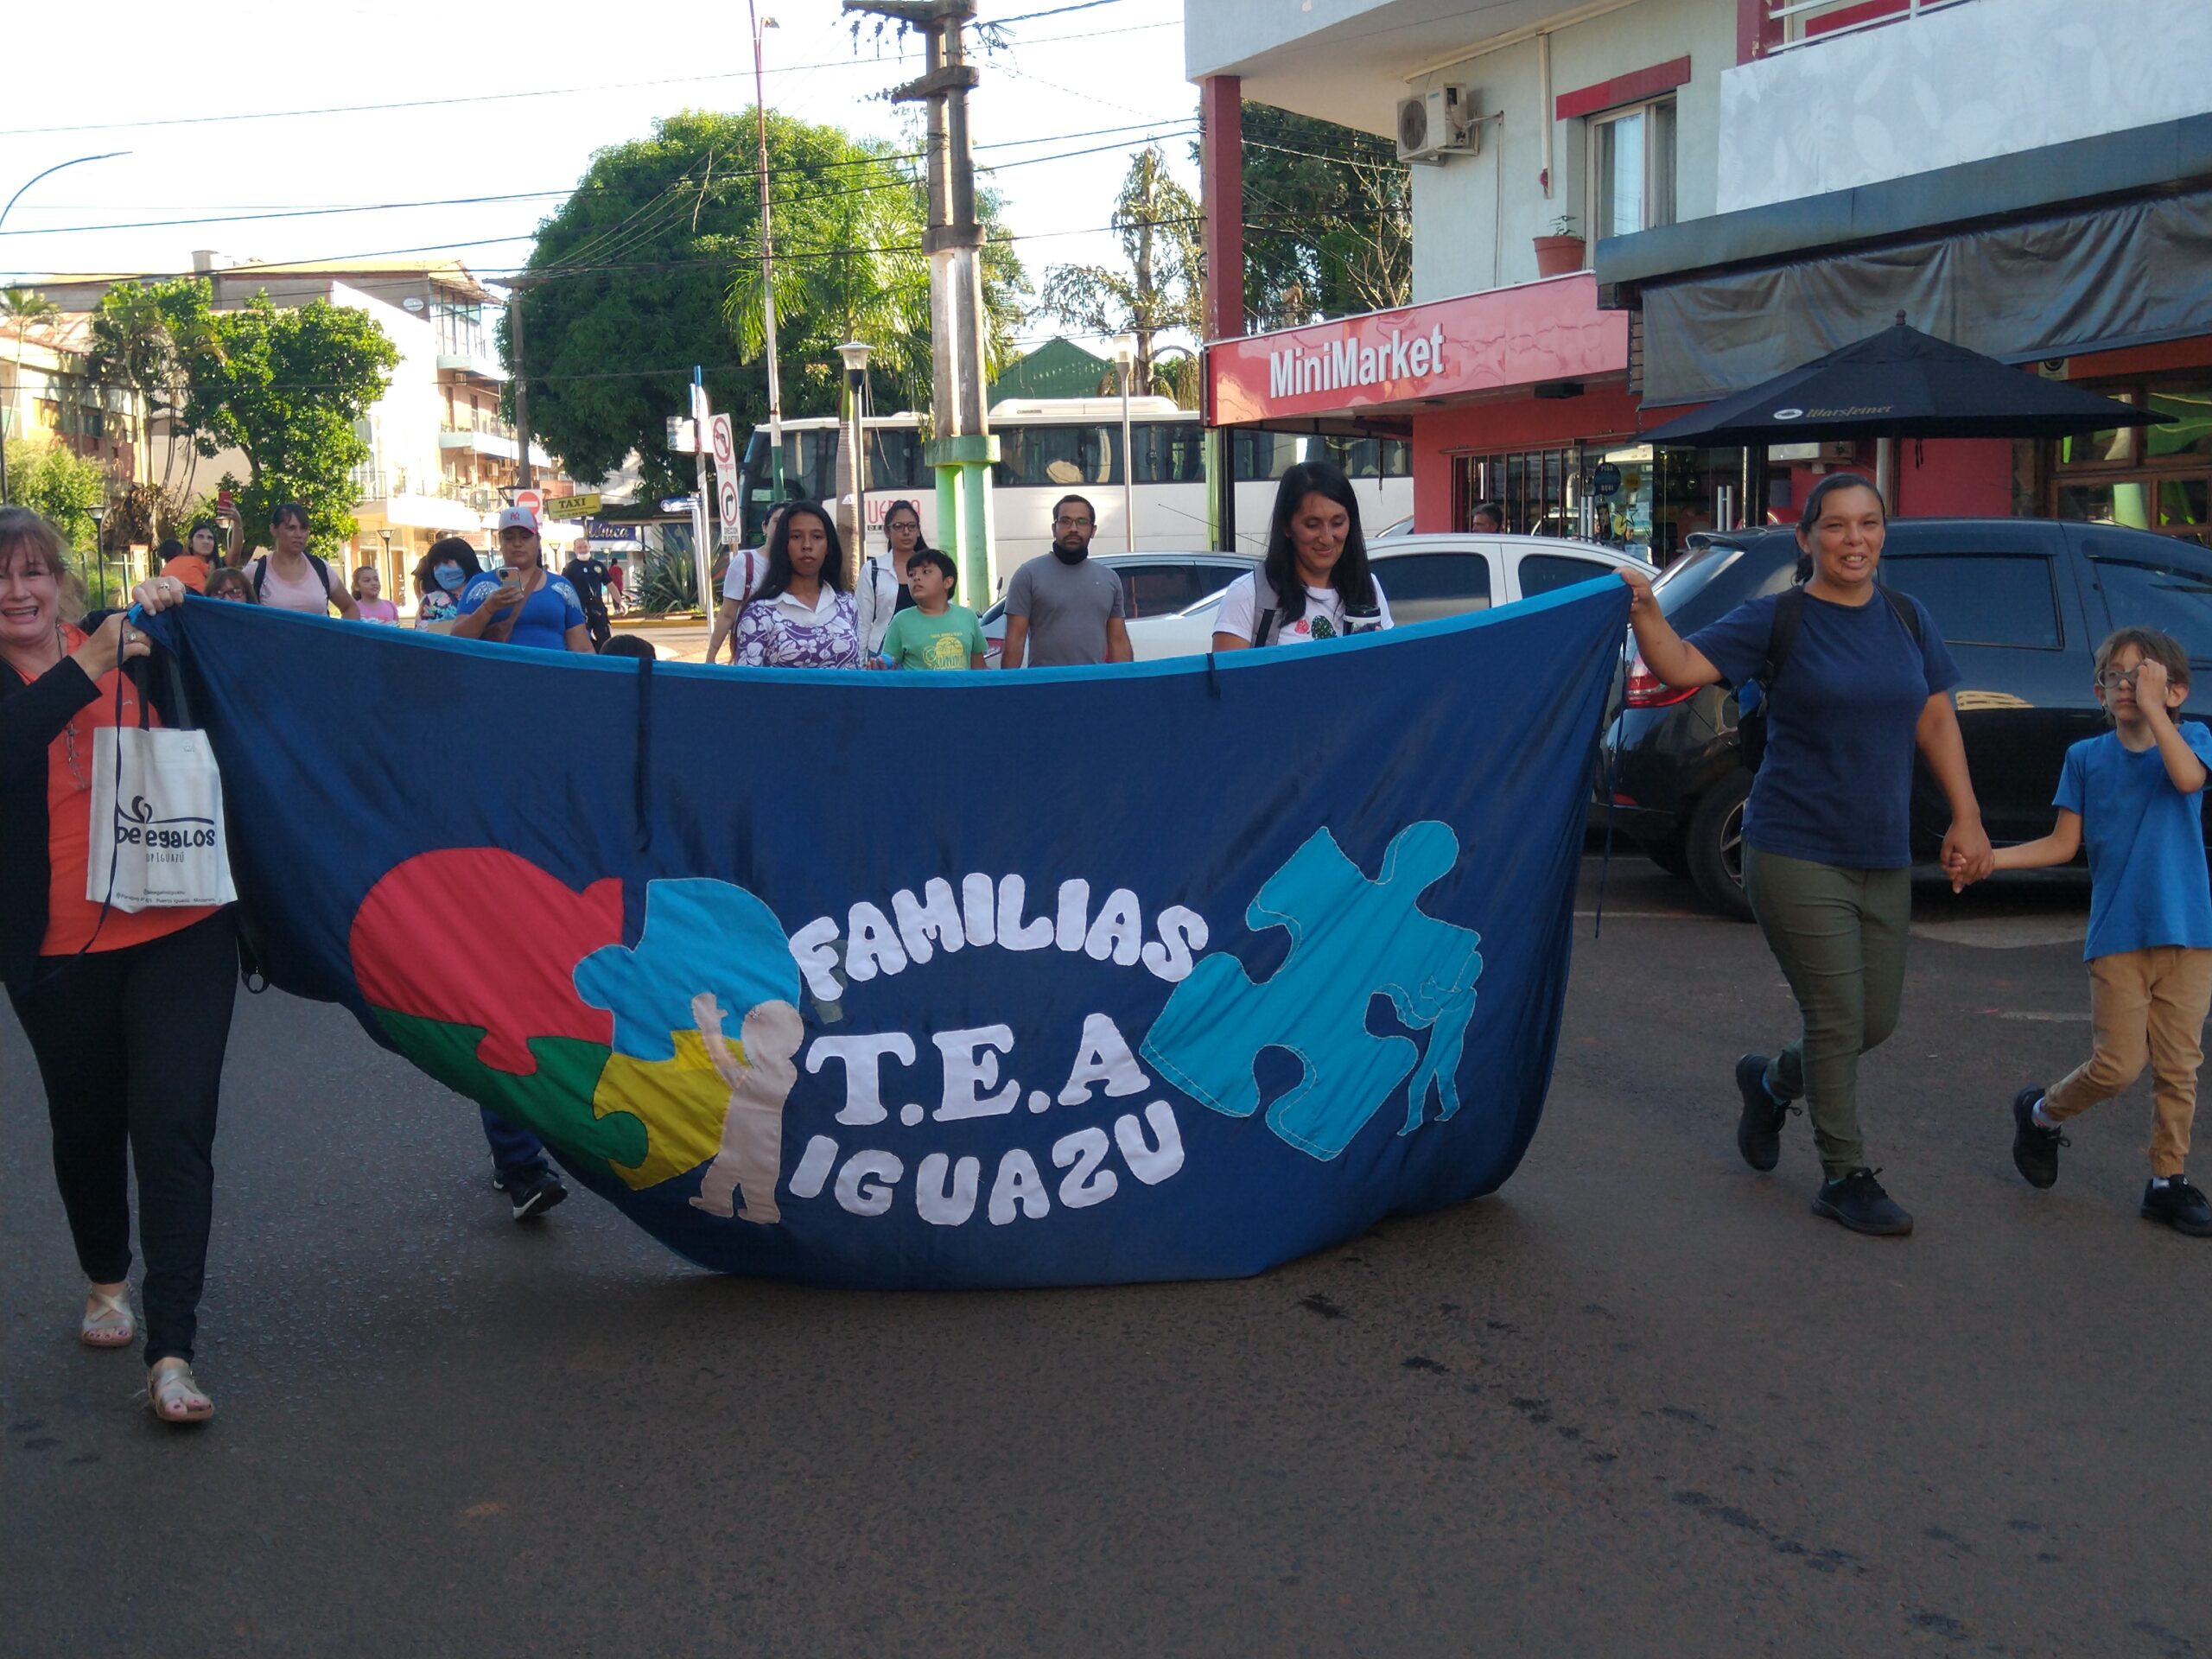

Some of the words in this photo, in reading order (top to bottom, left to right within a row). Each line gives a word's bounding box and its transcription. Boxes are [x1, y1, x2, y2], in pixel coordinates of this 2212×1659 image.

[1270, 323, 1446, 398] MiniMarket
[558, 498, 587, 510] TAXI
[789, 872, 1209, 1001] FAMILIAS
[805, 1013, 1150, 1127] T.E.A
[789, 1100, 1185, 1226] IGUAZU
